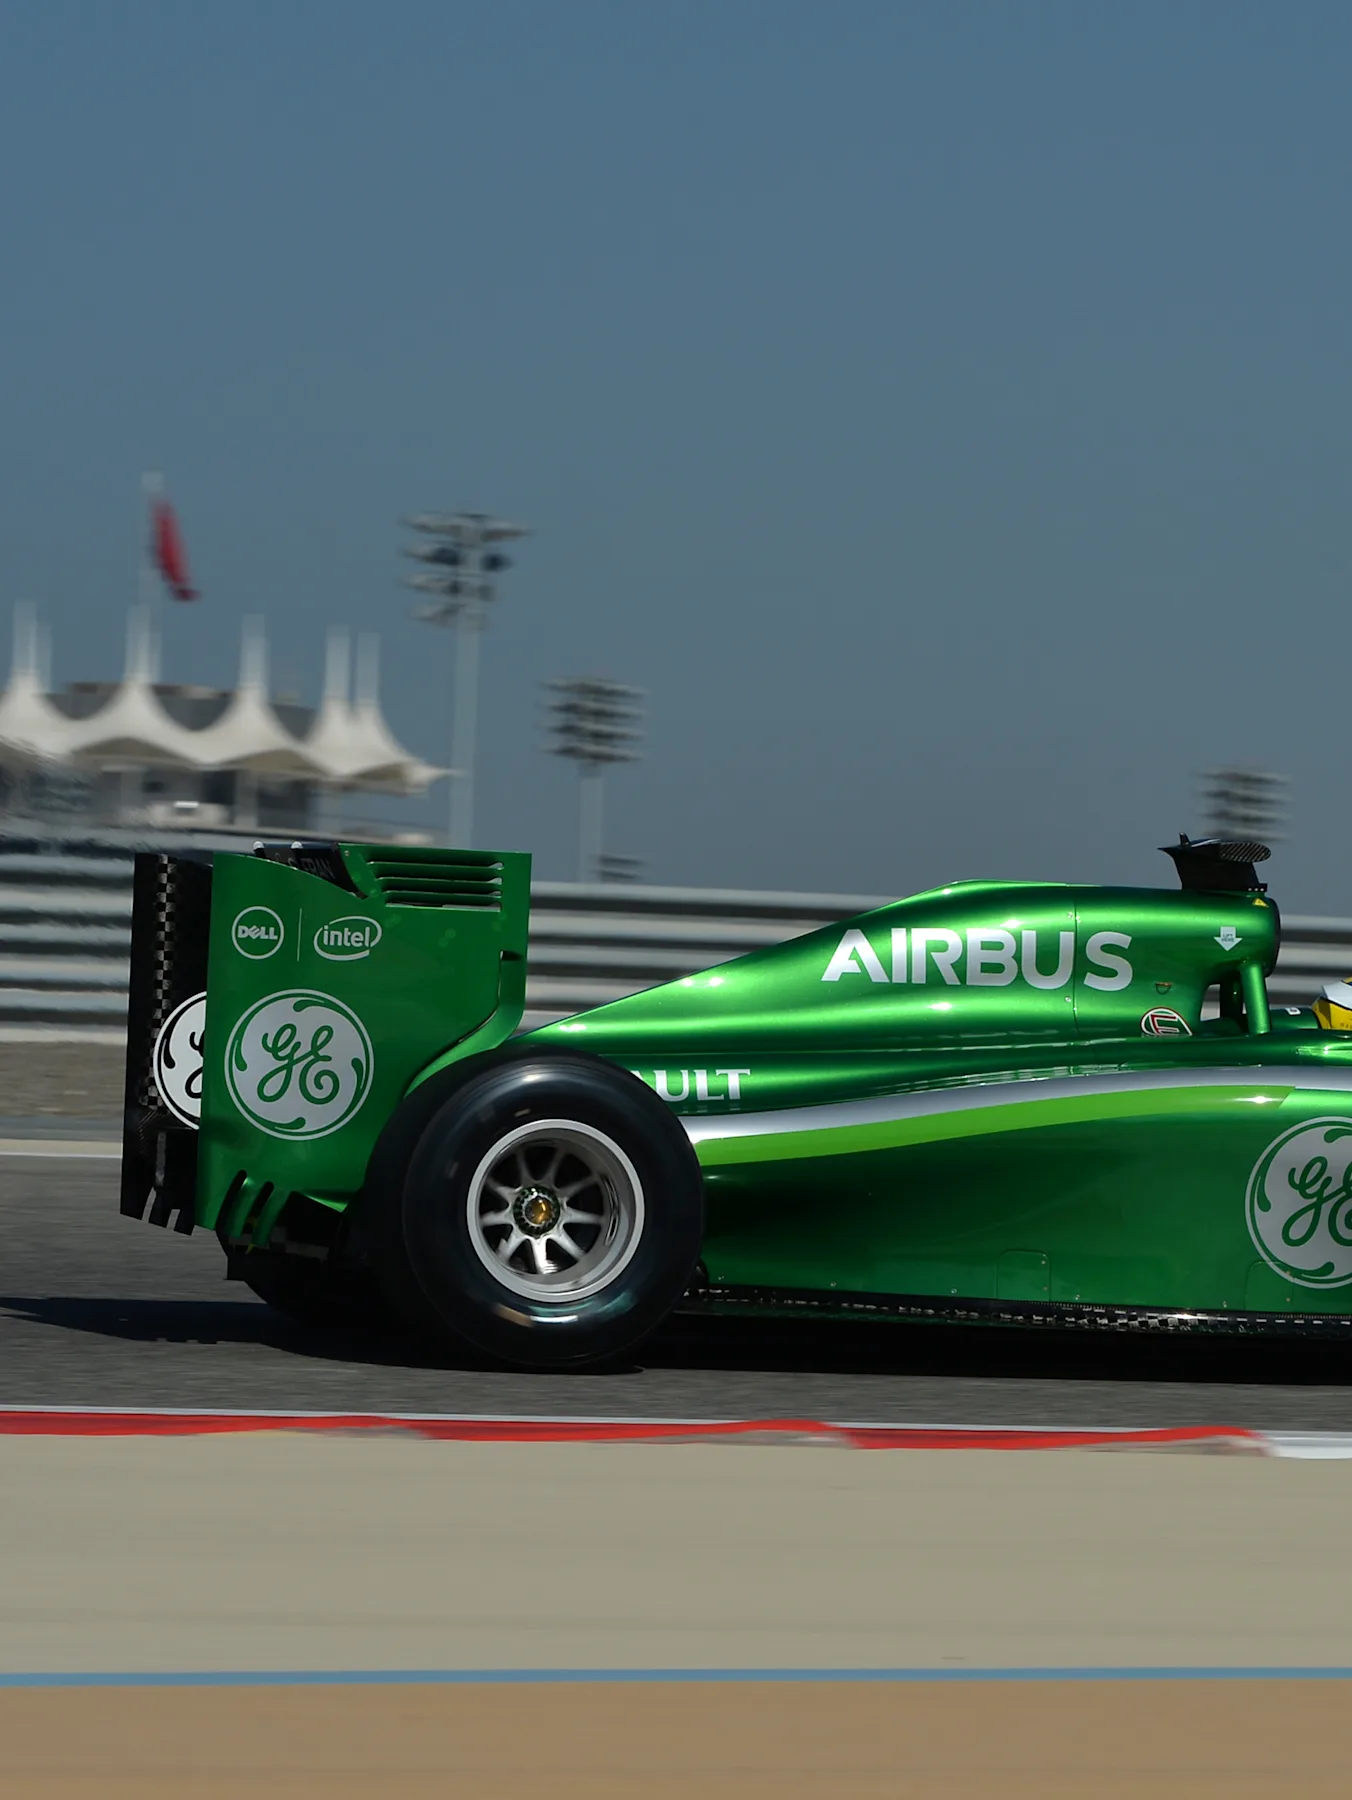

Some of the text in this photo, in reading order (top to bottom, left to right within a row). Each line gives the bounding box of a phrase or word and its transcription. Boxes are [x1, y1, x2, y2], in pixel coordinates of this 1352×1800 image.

[237, 925, 278, 940] DELL
[323, 925, 370, 947] intel
[820, 927, 1134, 991] AIRBUS
[256, 1022, 341, 1105] GE
[630, 1068, 751, 1102] ULT
